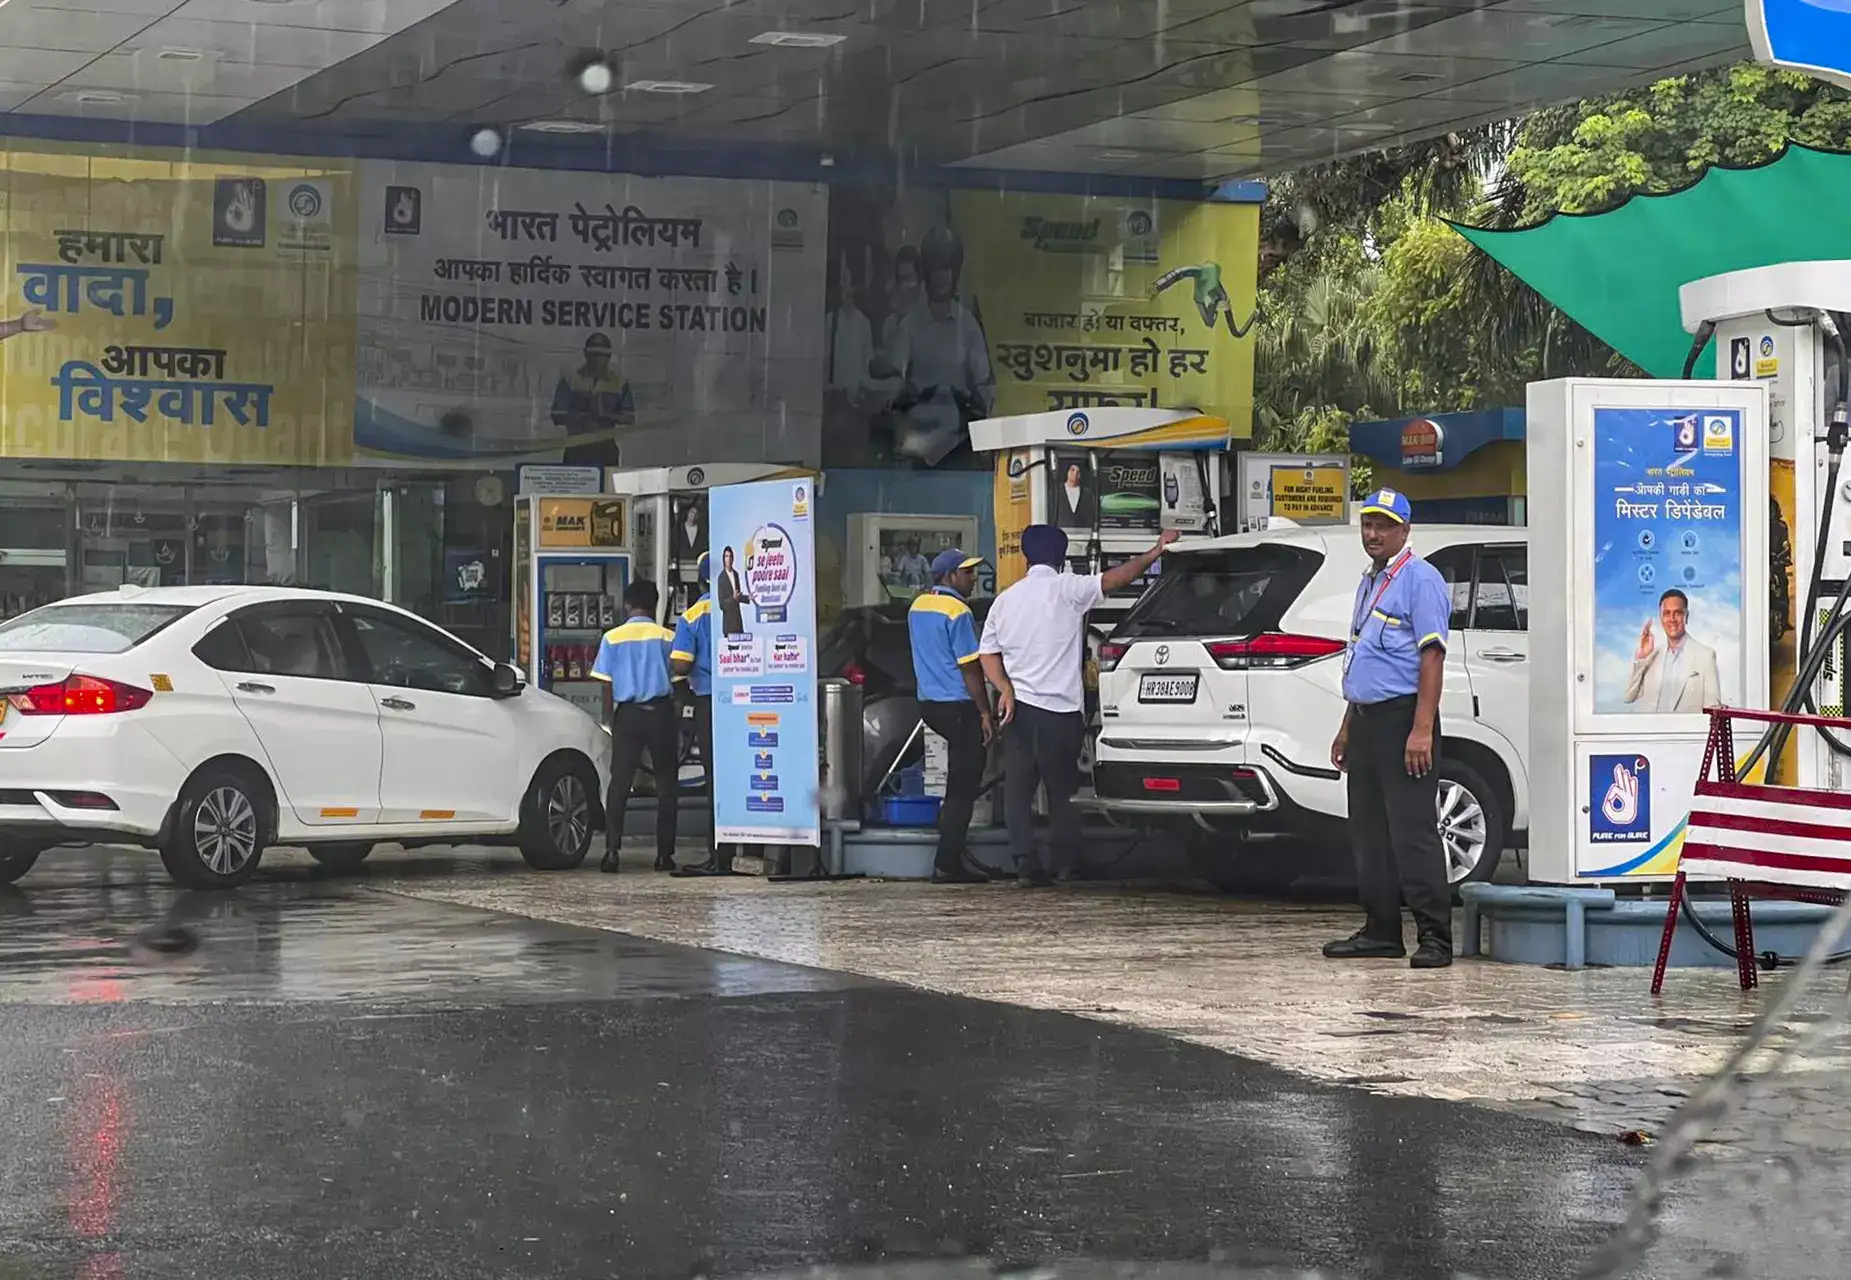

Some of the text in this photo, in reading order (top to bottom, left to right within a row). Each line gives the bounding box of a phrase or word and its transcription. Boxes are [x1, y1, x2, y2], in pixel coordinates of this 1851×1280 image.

[486, 202, 702, 251] भारत पेट्रोलियम
[53, 230, 164, 264] हमारा
[433, 257, 500, 284] आपका
[508, 255, 570, 285] हार्दिक
[578, 264, 651, 291] स्वागत
[658, 267, 716, 293] करता
[17, 263, 174, 330] वादा,
[420, 295, 766, 333] MODERN SERVICE STATION
[1105, 313, 1125, 331] या
[1130, 315, 1185, 335] दफ्तर,
[100, 345, 227, 380] आपका
[996, 338, 1210, 381] खुशनुमा हो हर
[51, 361, 274, 427] विश्वास
[1109, 465, 1157, 489] Speed
[1284, 485, 1295, 494] FOR
[1296, 485, 1311, 494] NIGHT
[1275, 494, 1305, 502] CUSTOMERS
[1284, 504, 1291, 512] TO
[1292, 504, 1302, 512] PAY
[1311, 504, 1334, 512] ADVANCE
[1615, 499, 1726, 520] मिस्टर डिपेंडेबल
[556, 515, 587, 526] MAK
[1592, 832, 1614, 840] PURE
[1627, 831, 1648, 839] SURE
